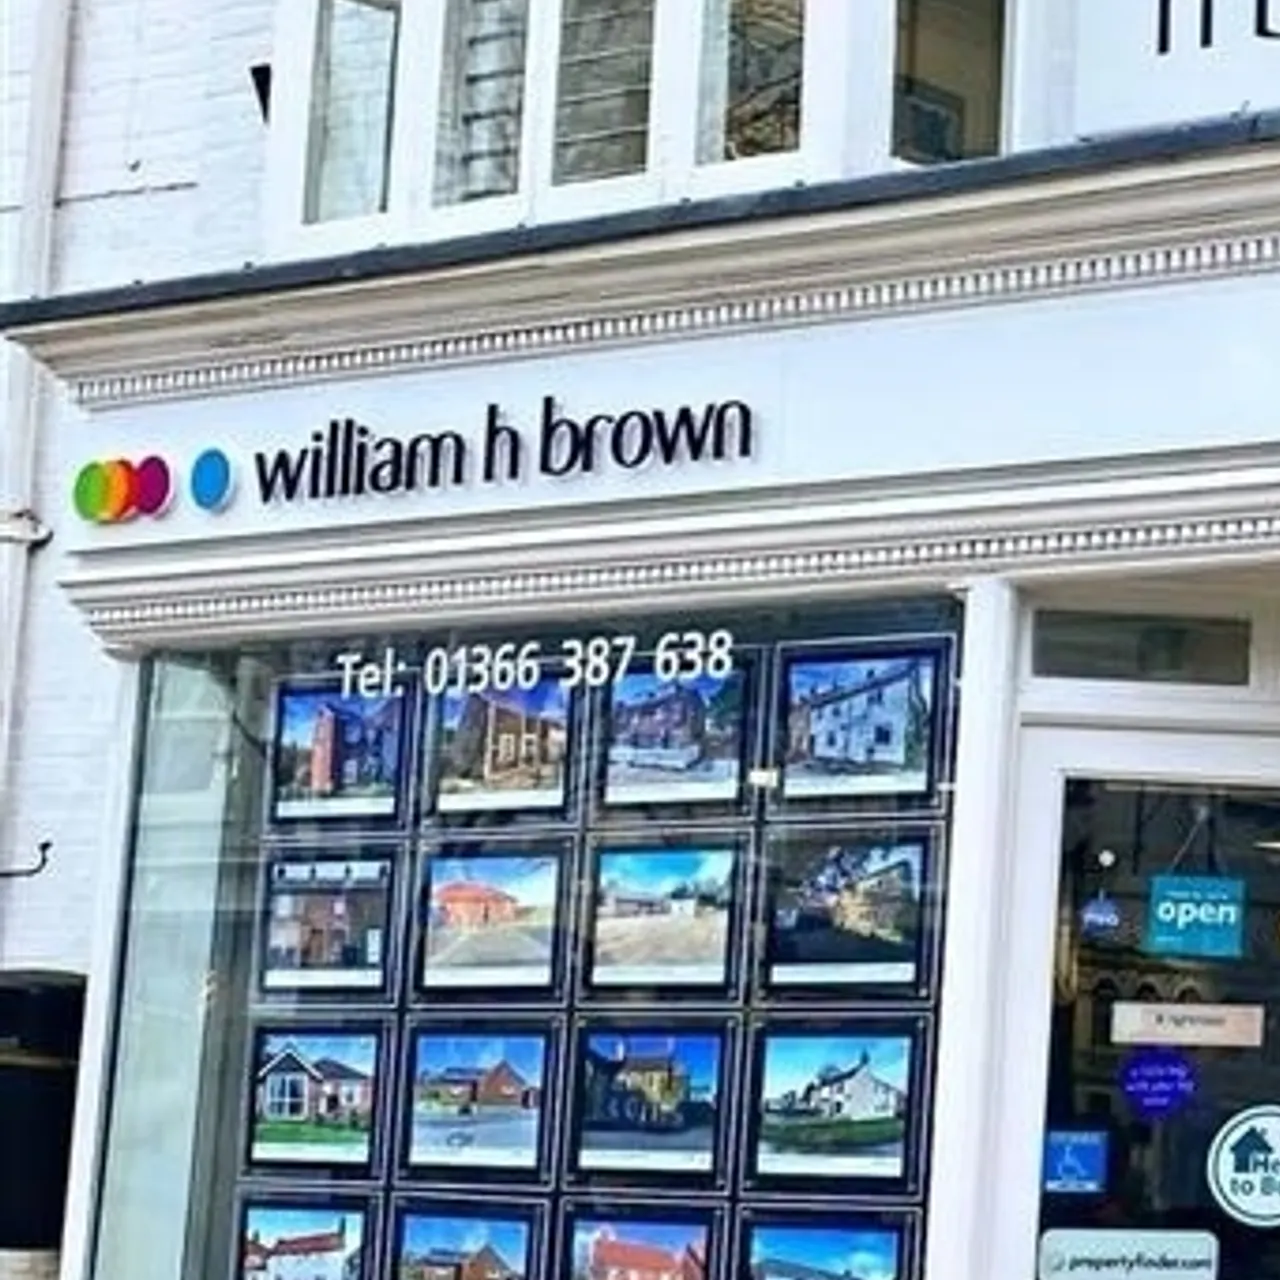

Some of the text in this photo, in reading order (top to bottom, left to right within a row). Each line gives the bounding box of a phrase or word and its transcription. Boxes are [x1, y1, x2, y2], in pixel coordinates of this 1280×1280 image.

[255, 396, 752, 504] william h brown
[337, 630, 734, 699] Tel: 01366 387 638
[1158, 902, 1236, 929] open
[1230, 1178, 1254, 1197] to
[1068, 1255, 1213, 1273] propertyfinder.com
